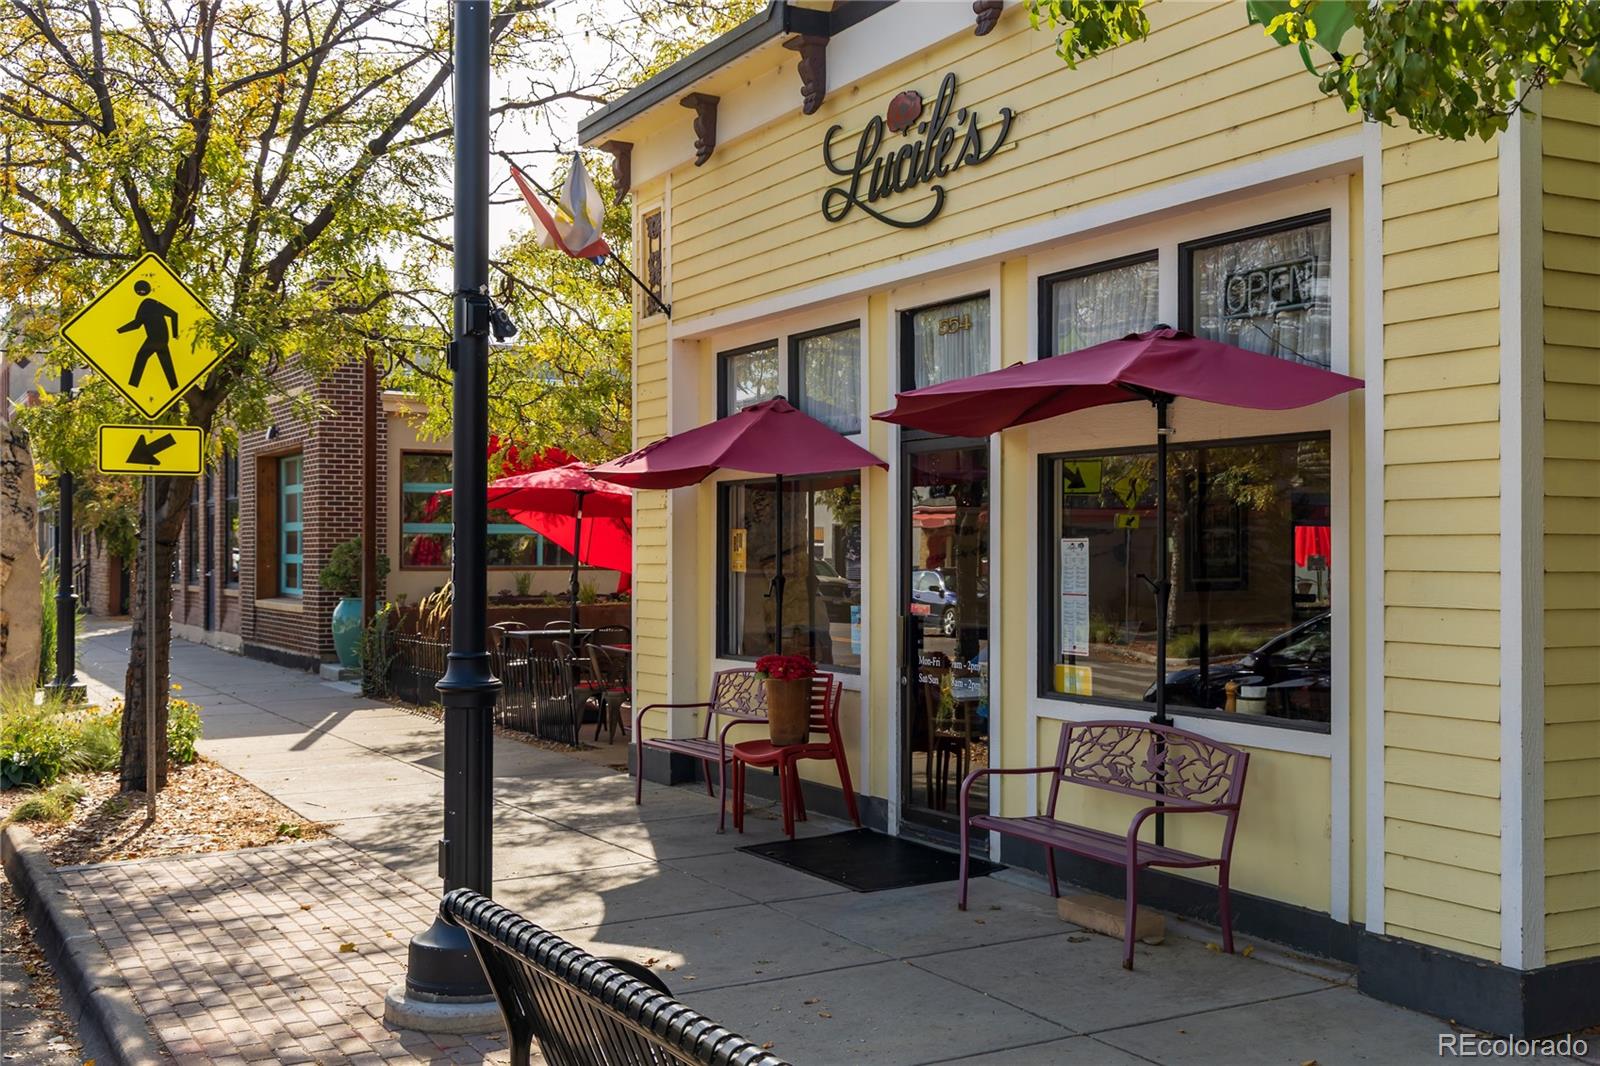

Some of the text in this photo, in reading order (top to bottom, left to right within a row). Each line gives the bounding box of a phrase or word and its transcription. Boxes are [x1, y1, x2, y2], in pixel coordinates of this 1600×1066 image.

[822, 72, 1013, 229] Lucile's
[1227, 263, 1312, 314] OPEN
[938, 314, 973, 336] 554
[918, 656, 941, 667] Mon-Fri
